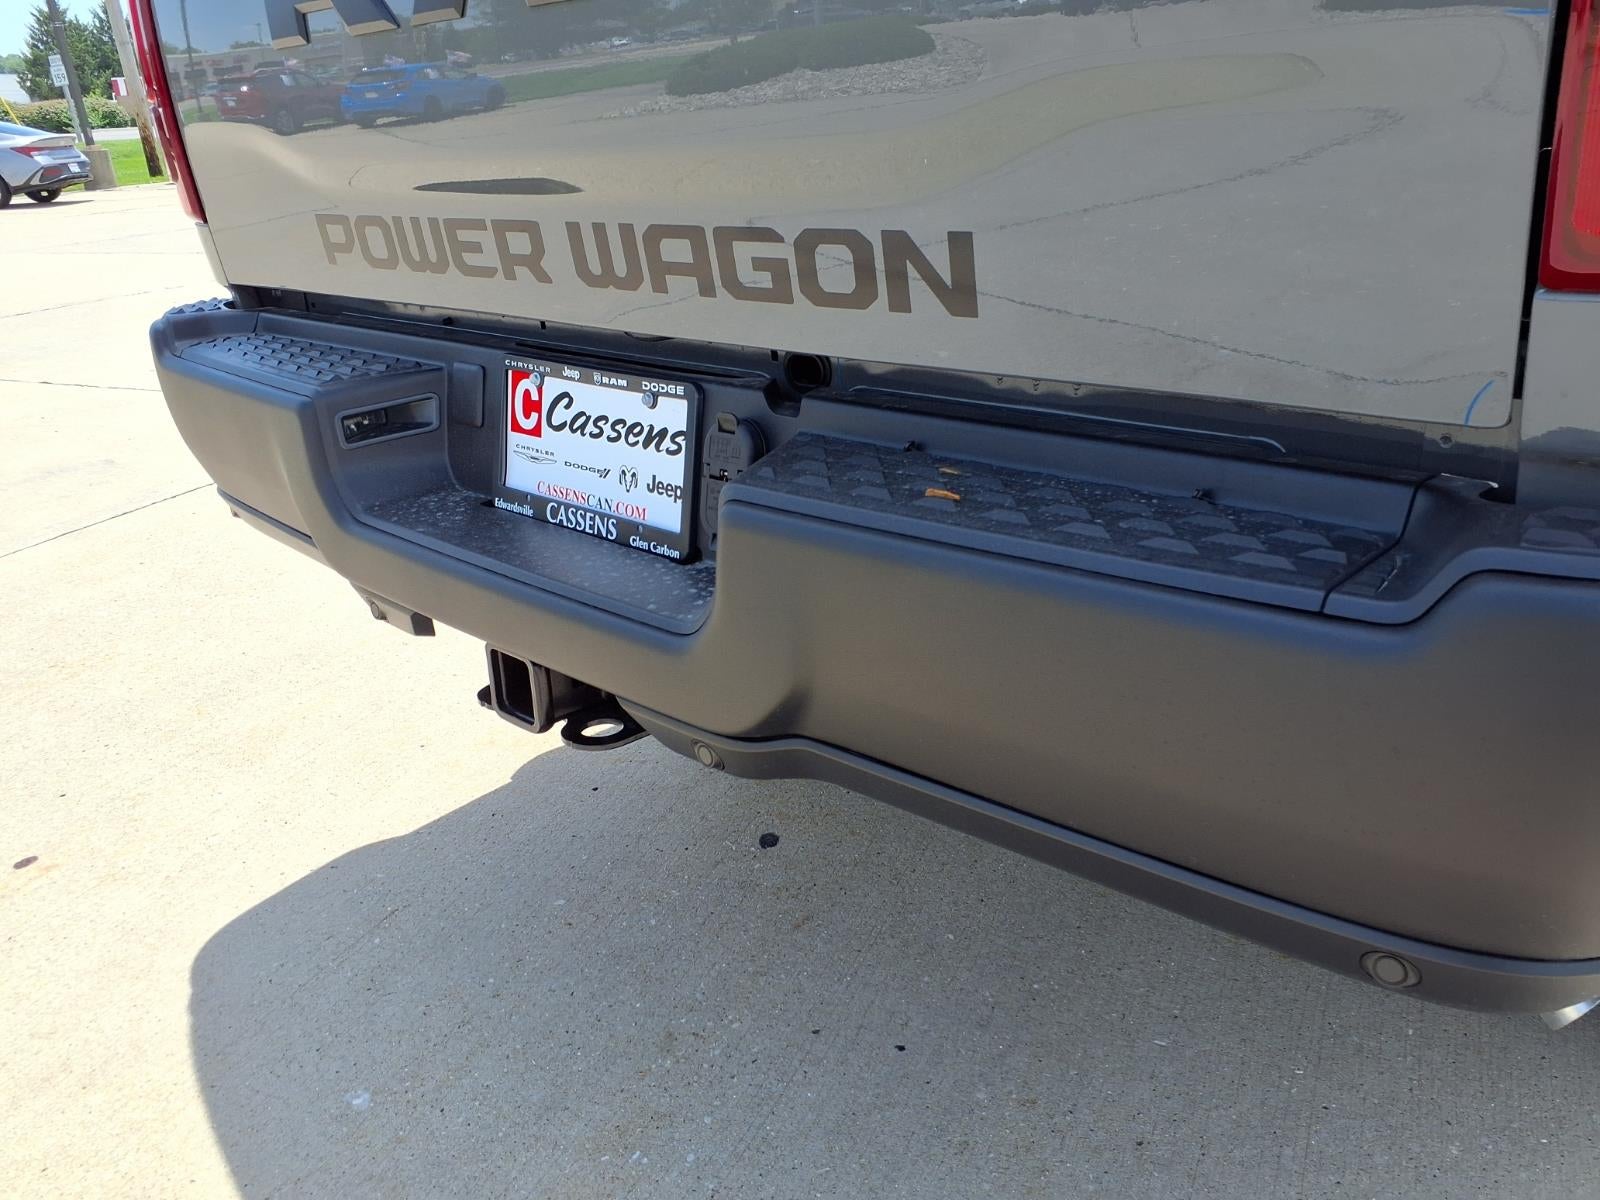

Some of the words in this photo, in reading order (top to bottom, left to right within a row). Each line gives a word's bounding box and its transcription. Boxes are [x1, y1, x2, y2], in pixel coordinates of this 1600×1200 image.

[315, 213, 553, 284] POWER
[565, 220, 979, 319] WAGON
[505, 359, 551, 374] CHRYSLER
[562, 366, 581, 380] Jeep
[601, 376, 628, 387] RAM
[641, 381, 685, 395] DODGE
[514, 378, 540, 430] C
[546, 391, 686, 456] Cassens
[515, 443, 555, 456] CHRYSLER
[564, 461, 606, 476] DODGE
[646, 474, 683, 503] Jeep
[494, 497, 534, 518] Edwardsville
[536, 480, 647, 521] CASSENSCAN.COM
[546, 502, 617, 540] CASSENS
[629, 535, 649, 551] Glen
[650, 542, 680, 559] Carbon
